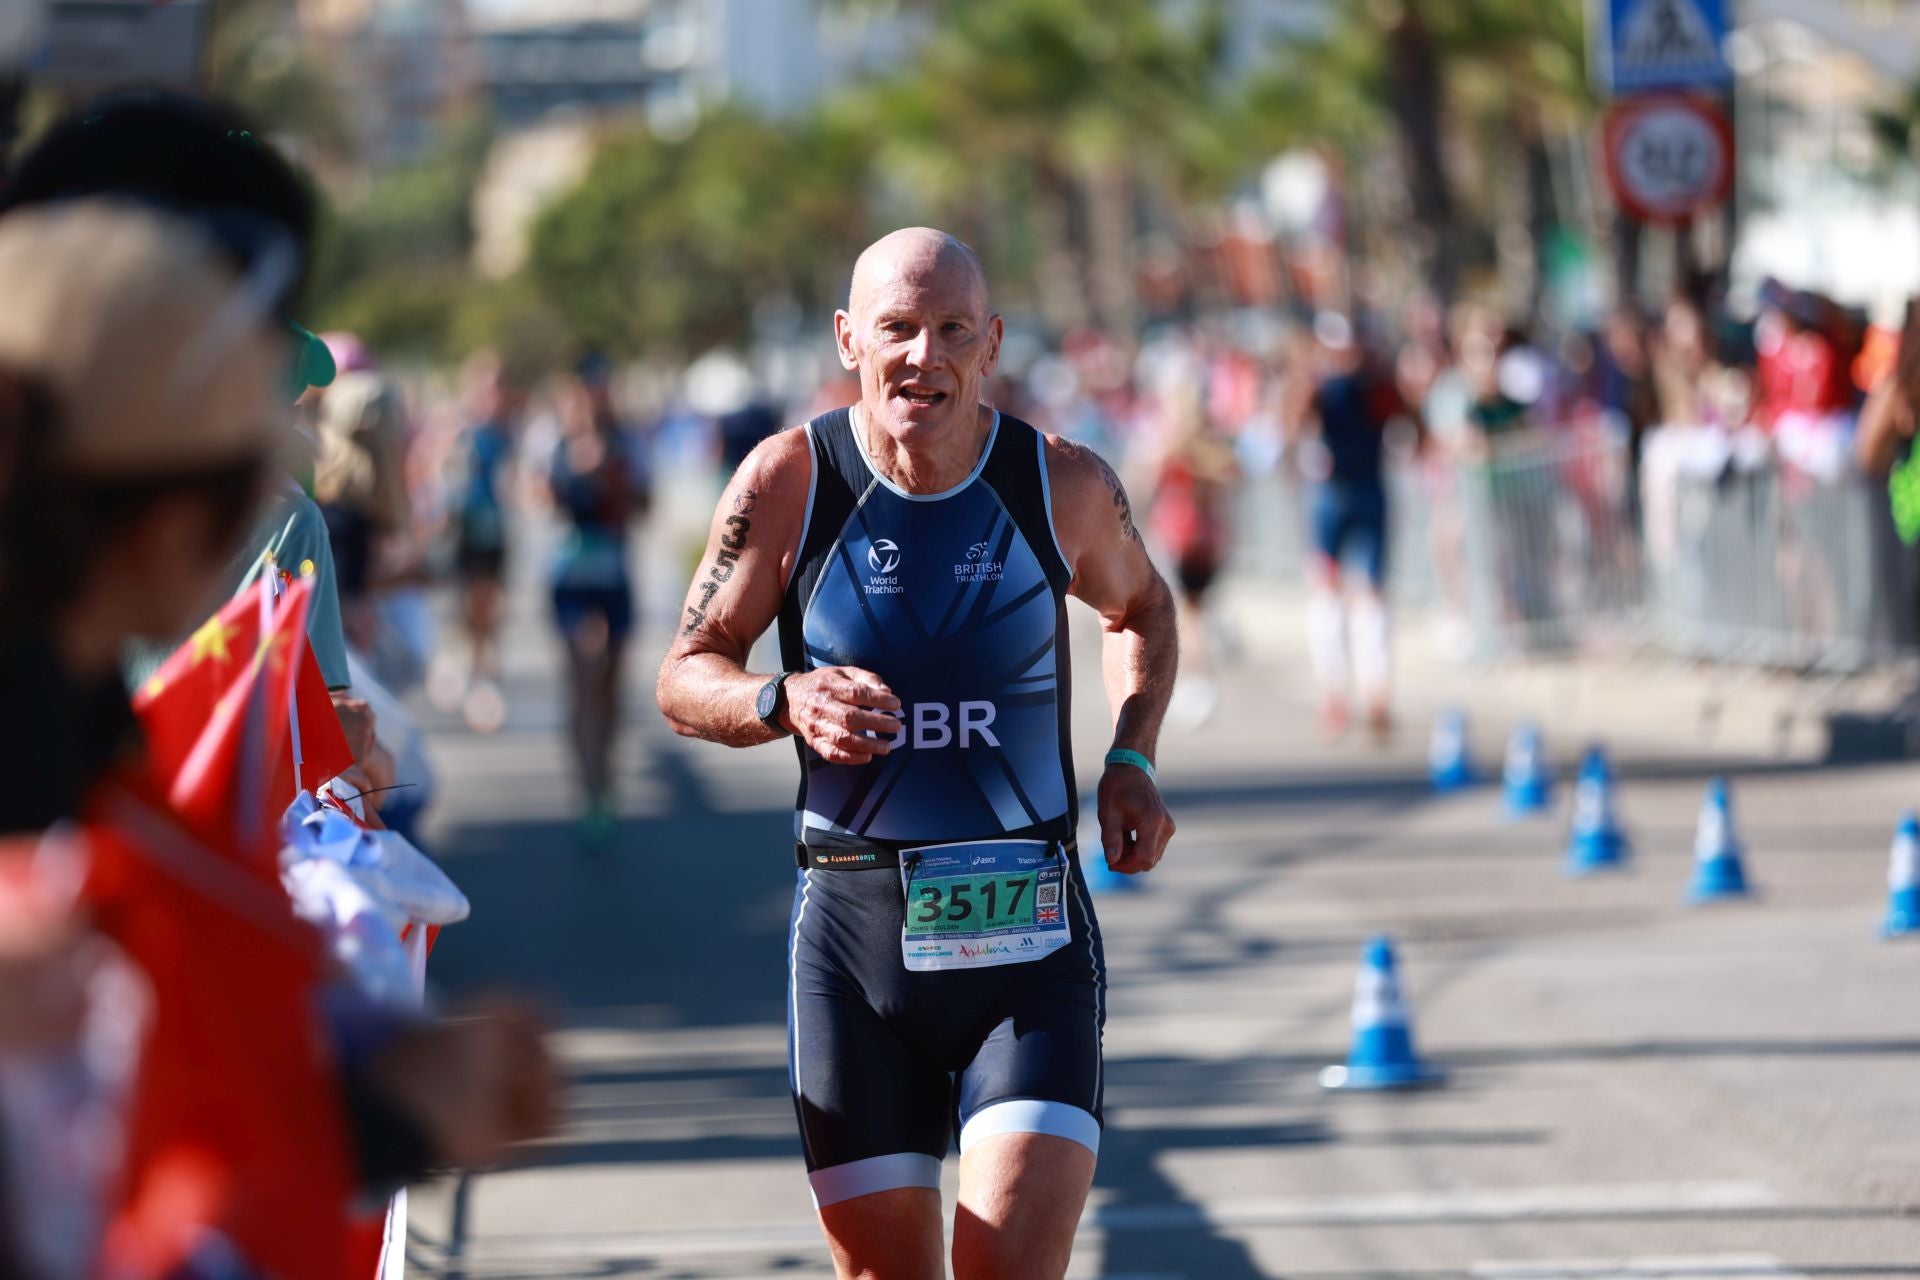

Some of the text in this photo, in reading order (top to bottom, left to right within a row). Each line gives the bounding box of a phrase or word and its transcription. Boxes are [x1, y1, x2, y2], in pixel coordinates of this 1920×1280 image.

[954, 561, 1002, 574] BRITISH
[870, 576, 897, 585] World
[954, 573, 1004, 583] TRIATHLON
[864, 585, 904, 594] Triathlon
[917, 879, 1030, 923] 3517
